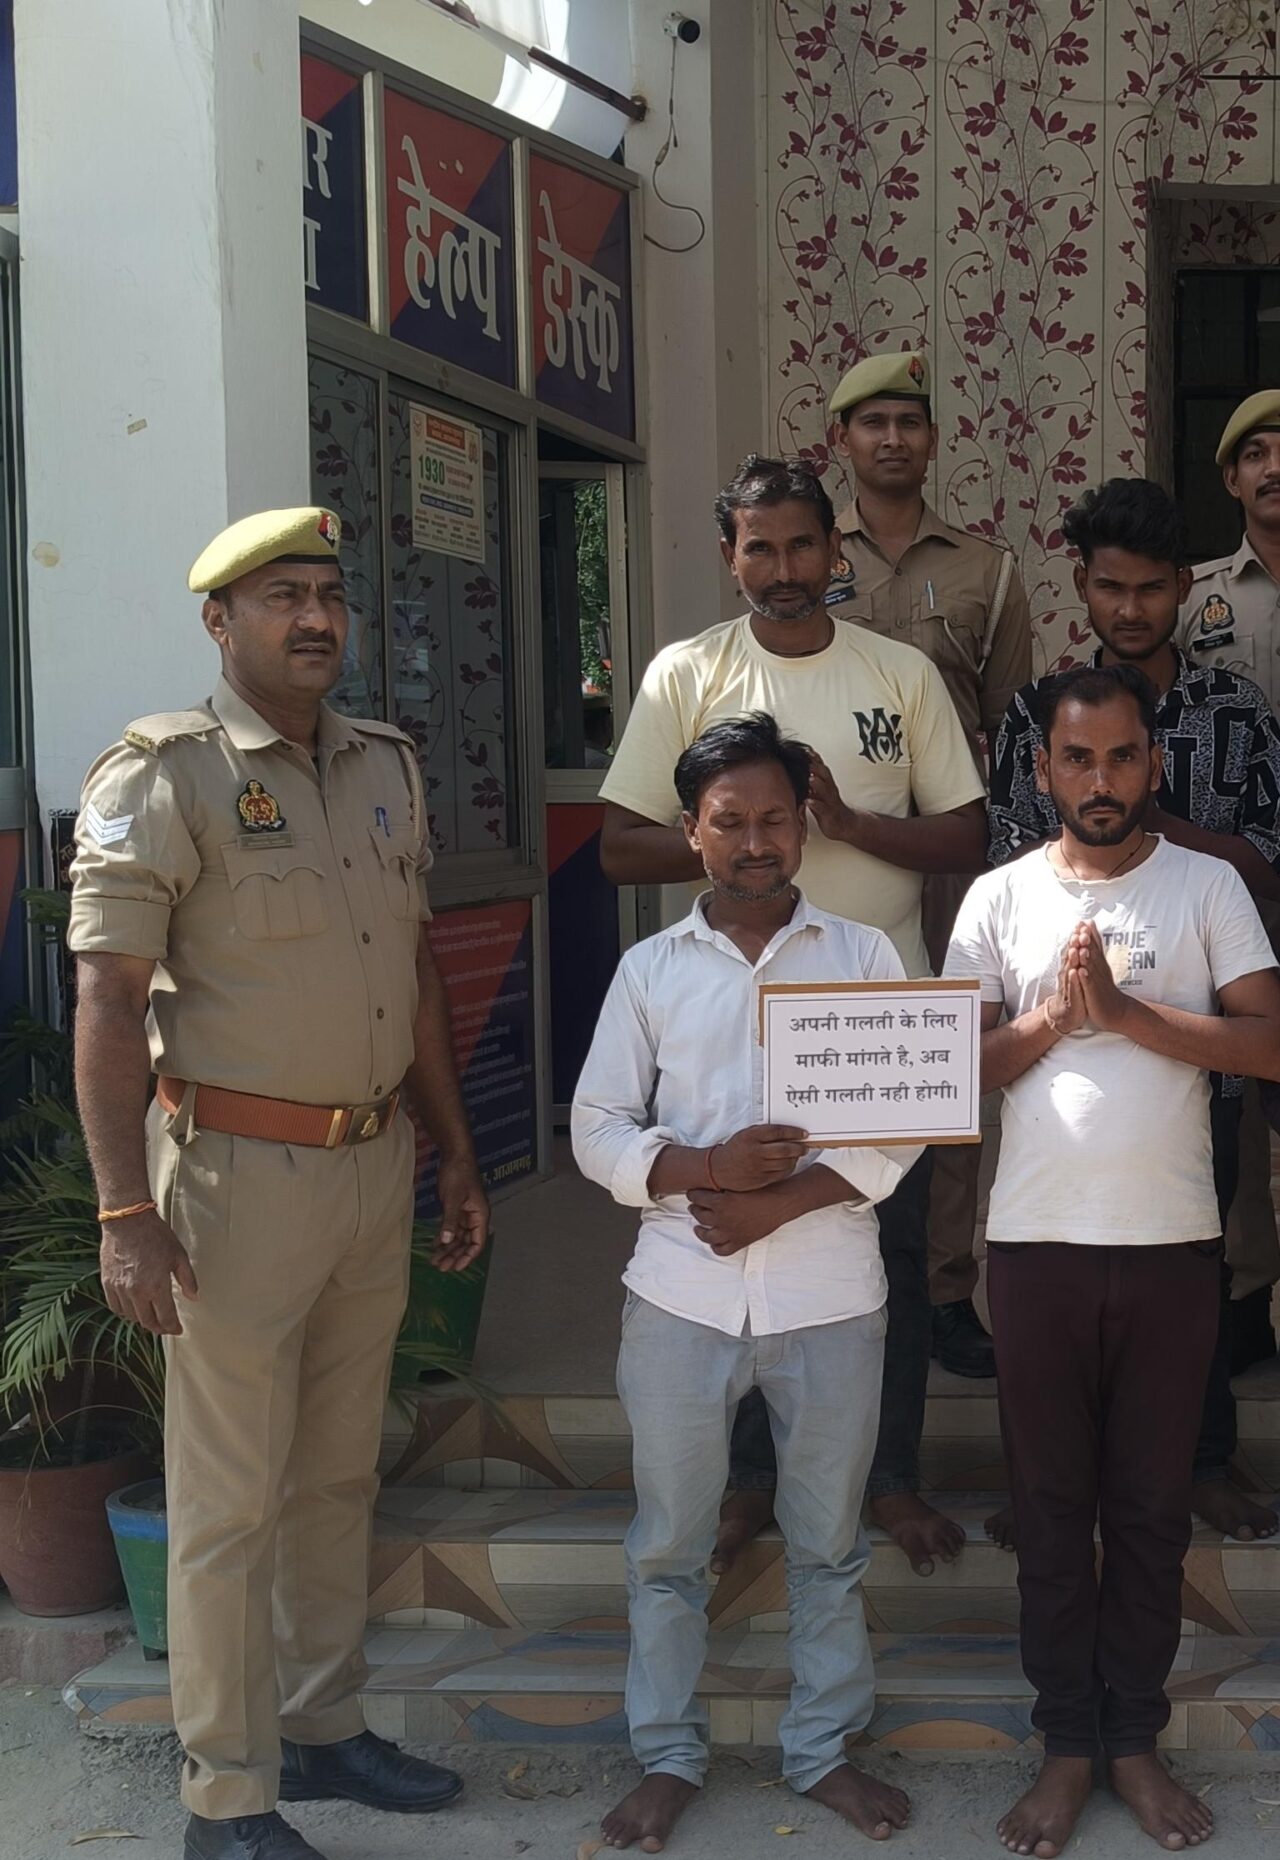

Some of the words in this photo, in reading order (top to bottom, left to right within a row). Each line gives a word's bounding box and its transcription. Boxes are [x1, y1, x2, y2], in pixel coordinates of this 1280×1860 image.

[397, 134, 501, 341] हेल्प
[537, 190, 621, 393] डेस्क
[418, 454, 446, 486] 1930
[789, 1012, 839, 1032] अपनी
[844, 1010, 894, 1030] गलती
[899, 1009, 917, 1029] के
[922, 1008, 958, 1032] लिए
[795, 1048, 840, 1068] माफी
[846, 1046, 893, 1066] मांगते
[920, 1049, 951, 1064] अब
[786, 1084, 819, 1108] ऐसी
[825, 1083, 874, 1103] गलती
[879, 1082, 910, 1102] नही
[914, 1080, 958, 1102] होगी।
